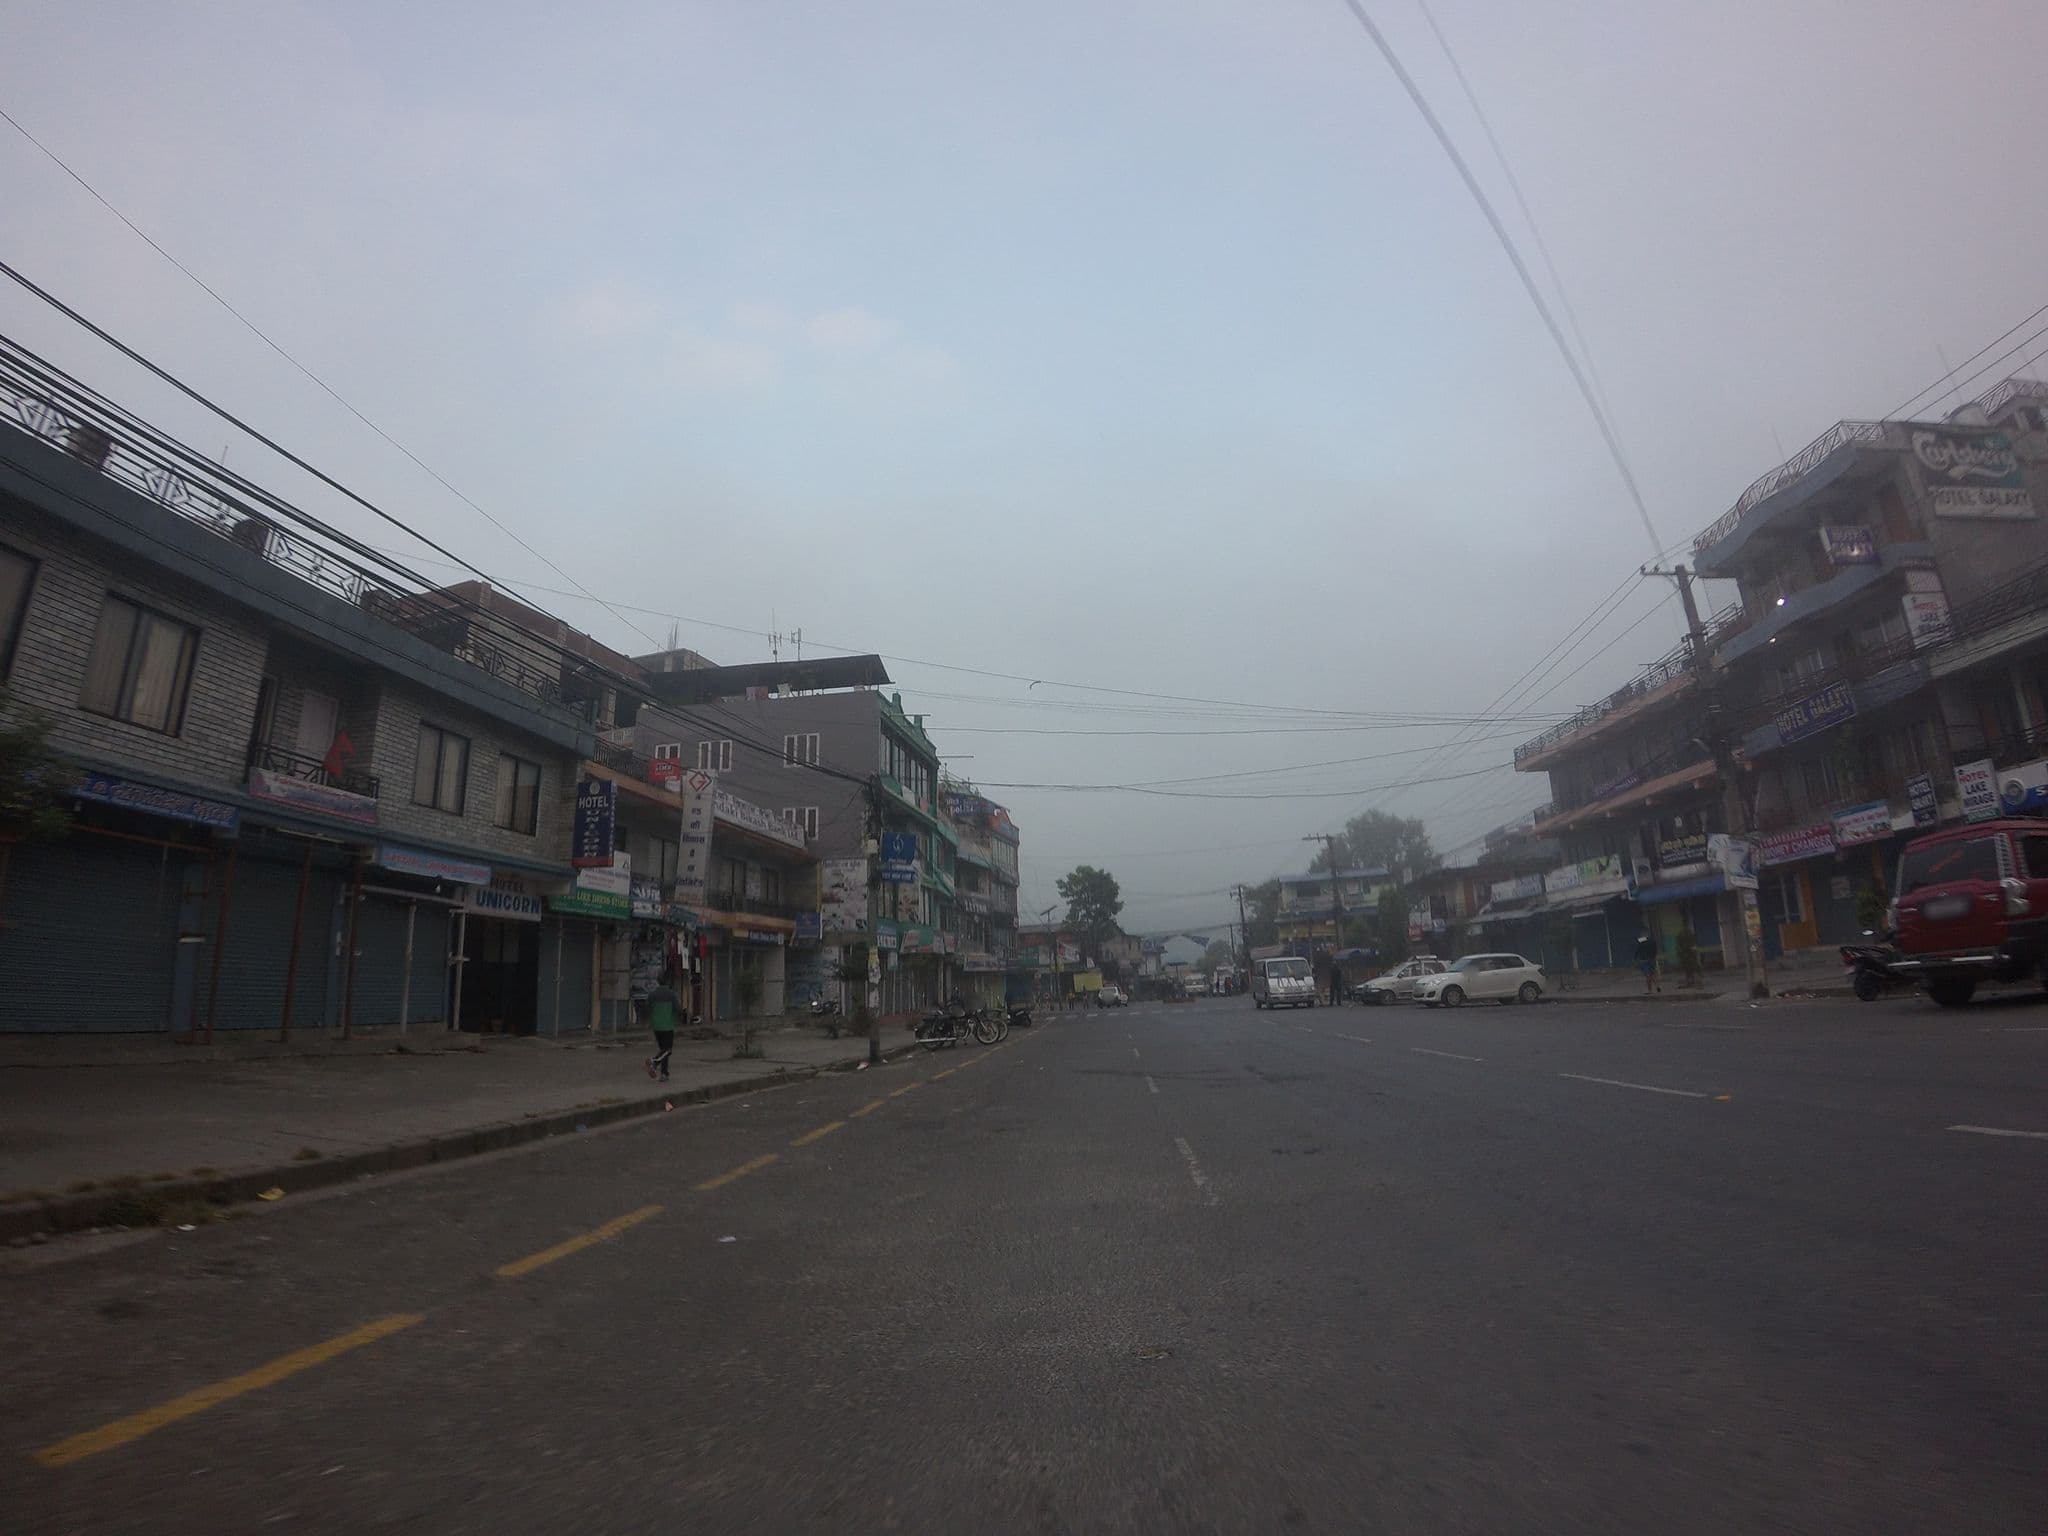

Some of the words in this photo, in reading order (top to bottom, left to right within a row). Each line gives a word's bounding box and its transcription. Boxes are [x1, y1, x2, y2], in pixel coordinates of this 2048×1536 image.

[1775, 702, 1810, 735] HOTEL
[1958, 770, 1990, 784] HOTEL
[1964, 781, 1988, 795] LAKE
[578, 795, 609, 809] HOTEL
[1963, 791, 1996, 809] MIRAGE
[1792, 833, 1835, 855] CHANGER
[489, 878, 525, 893] HOTEL
[475, 889, 541, 914] UNICORN
